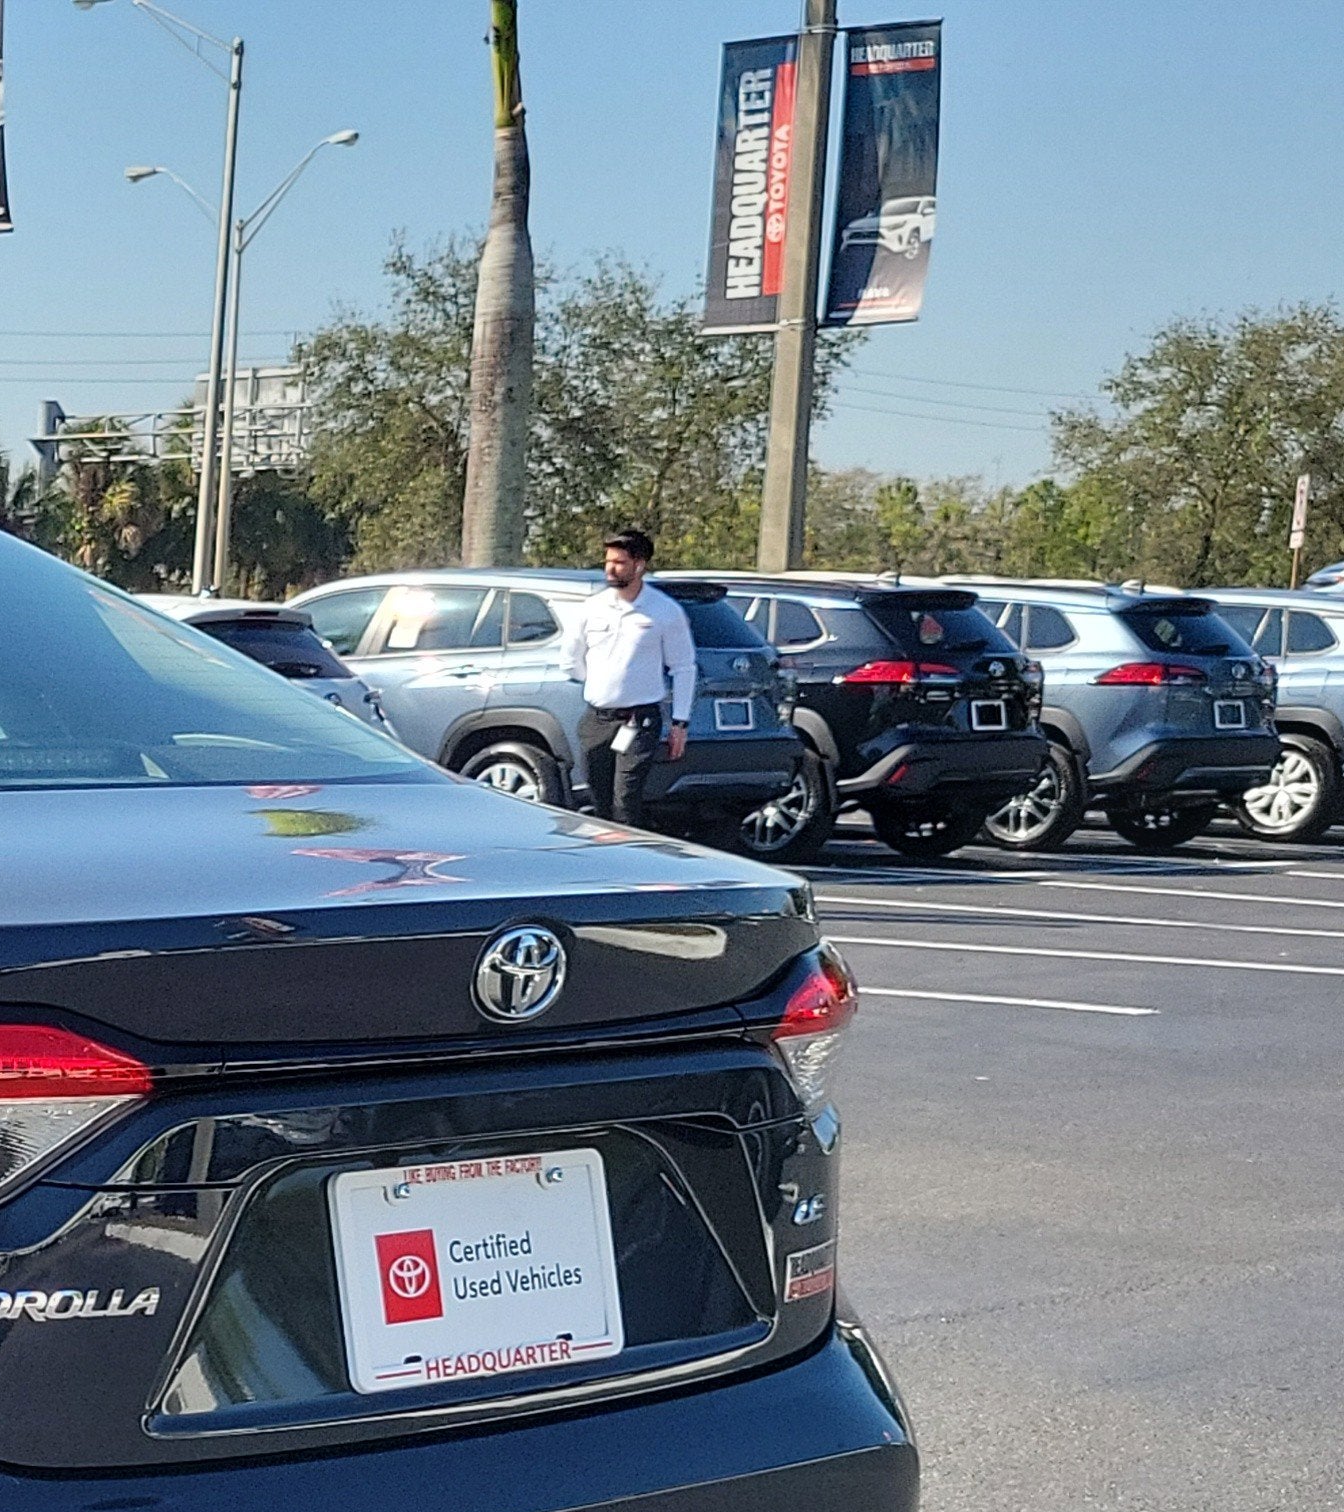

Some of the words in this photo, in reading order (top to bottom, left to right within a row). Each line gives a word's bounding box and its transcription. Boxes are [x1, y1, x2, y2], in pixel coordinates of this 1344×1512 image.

[725, 68, 773, 300] HEADQUARTER
[767, 124, 792, 213] TOYOTA
[449, 1230, 533, 1265] Certified
[453, 1271, 503, 1301] Used
[506, 1263, 583, 1294] Vehicles
[425, 1340, 573, 1381] HEADQUARTER
